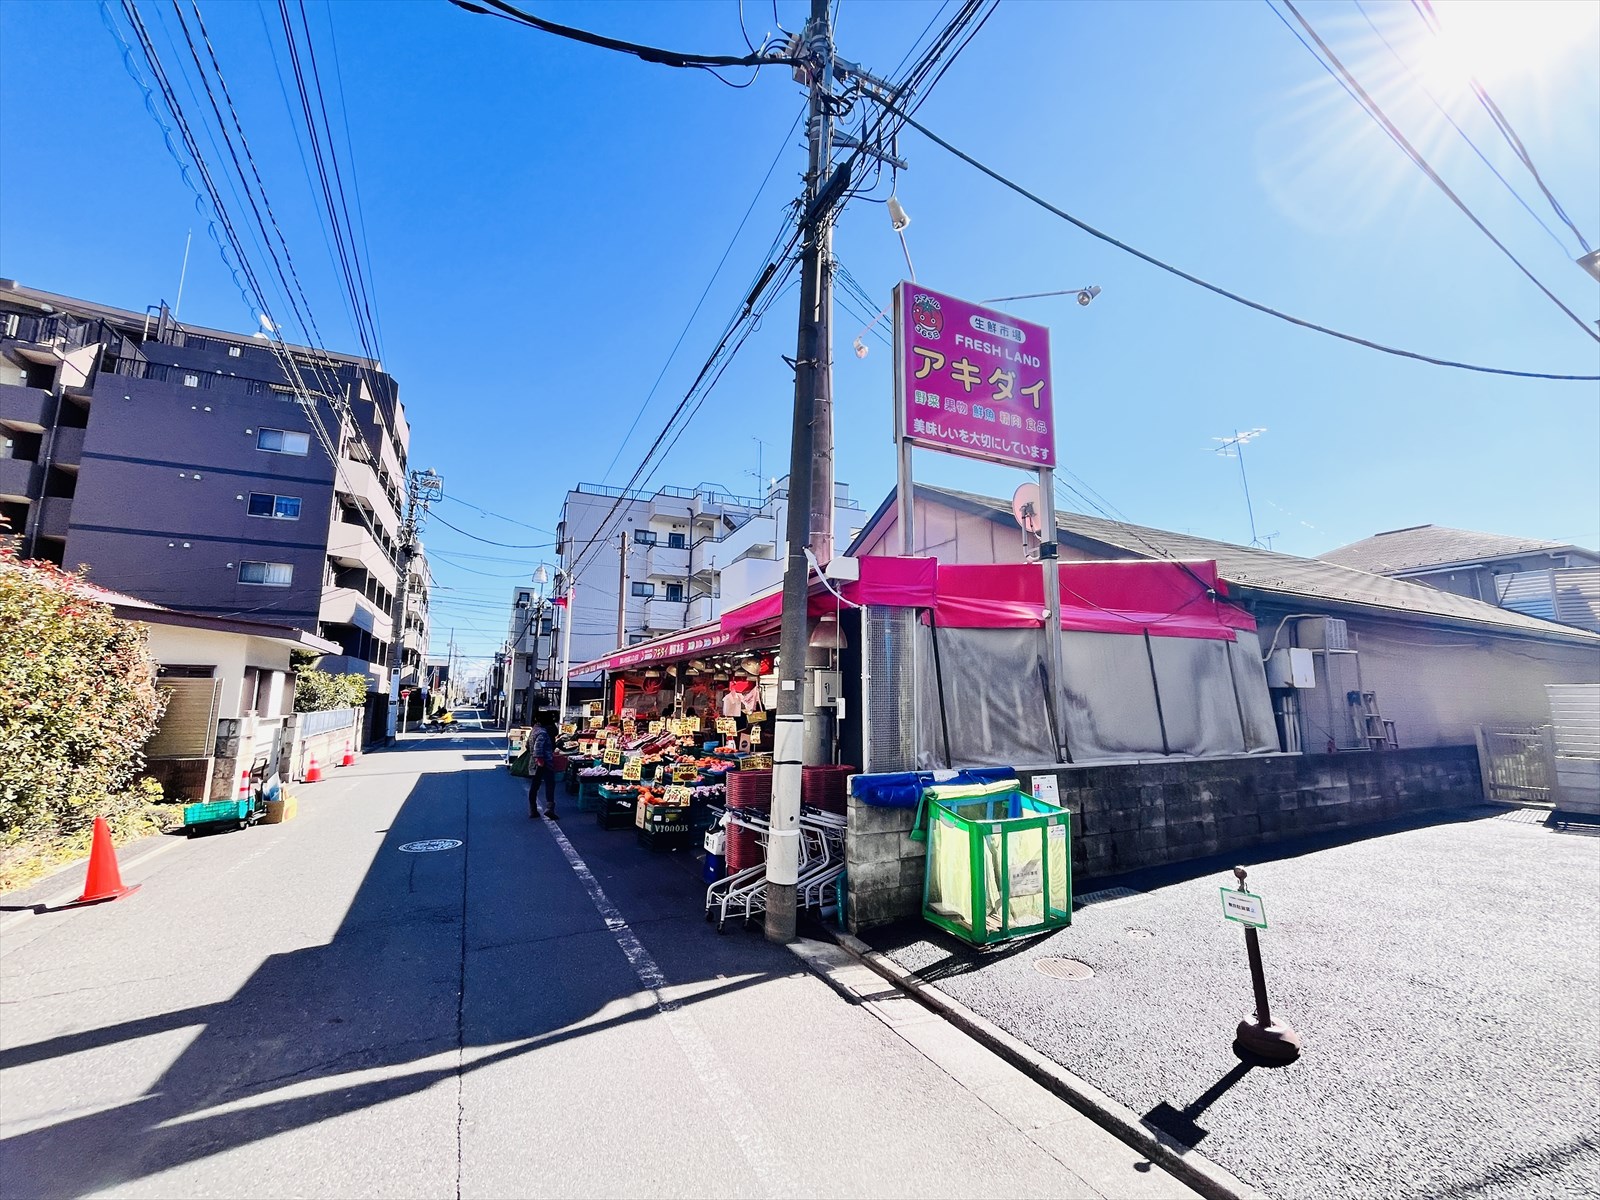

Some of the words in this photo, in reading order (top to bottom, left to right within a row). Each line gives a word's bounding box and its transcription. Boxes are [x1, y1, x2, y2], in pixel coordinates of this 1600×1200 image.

[913, 294, 941, 310] スマイル
[974, 317, 1022, 342] 生鮮市場
[954, 333, 1002, 358] FRESH
[1005, 348, 1041, 368] LAND
[912, 345, 1046, 410] アキダイ
[914, 389, 940, 409] 野菜
[943, 397, 968, 416] 果物
[972, 403, 996, 423] 鮮魚
[999, 411, 1023, 429] 精肉
[1025, 417, 1048, 435] 食品
[913, 418, 1050, 460] 美味しいを大切にしています
[655, 824, 689, 833] SEQUOIA
